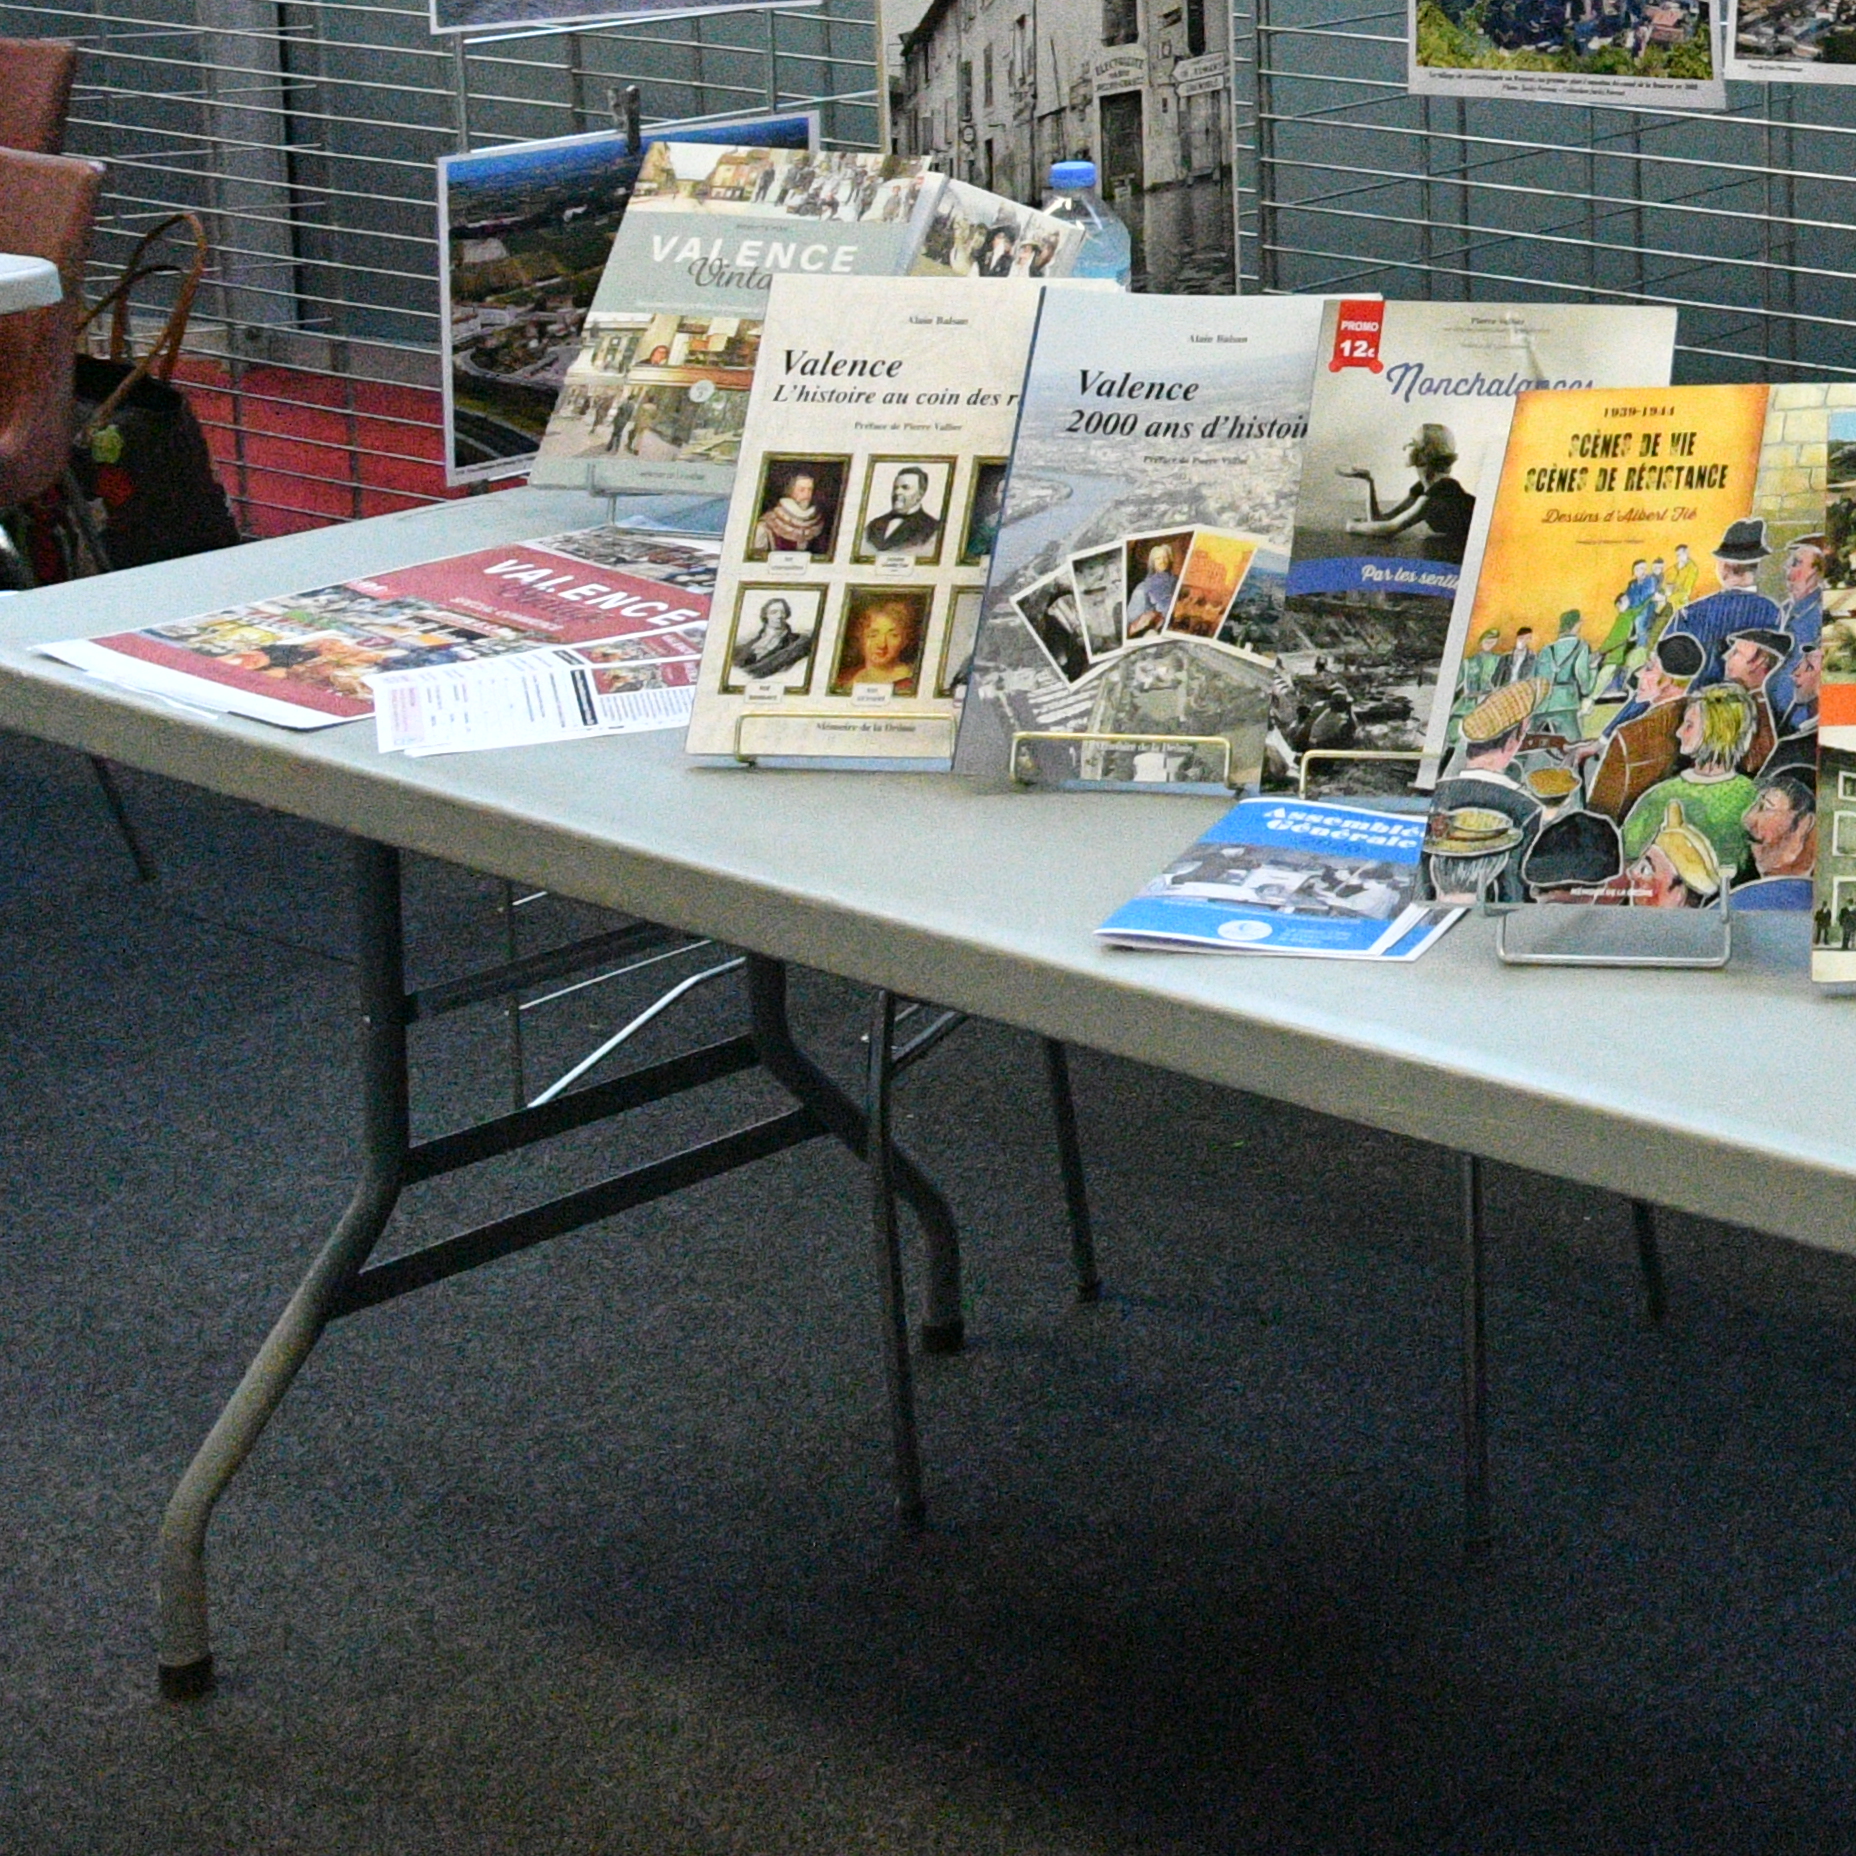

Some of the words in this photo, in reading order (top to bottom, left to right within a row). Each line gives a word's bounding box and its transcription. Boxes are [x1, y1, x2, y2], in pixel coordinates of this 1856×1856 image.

[651, 235, 858, 273] VALENCE
[687, 257, 773, 290] Vinta
[1341, 320, 1379, 332] PROMO
[783, 350, 903, 378] Valence
[773, 384, 876, 405] L'histoire
[882, 391, 909, 405] au
[916, 388, 960, 406] coin
[966, 388, 1000, 408] des
[1080, 368, 1199, 402] Valence
[1065, 409, 1138, 436] 2000
[1144, 417, 1194, 440] ans
[1201, 414, 1308, 440] d'histoi
[1603, 406, 1675, 418] 1939-1944
[1569, 429, 1632, 458] SCÈNES
[1639, 432, 1661, 457] DE
[1670, 431, 1697, 456] VIE
[1525, 463, 1588, 493] SCÈNES
[1595, 467, 1617, 492] DE
[1624, 463, 1729, 492] RÉSISTANCE
[1542, 508, 1599, 524] Dessins
[1362, 564, 1392, 584] Par
[1395, 566, 1417, 584] les
[484, 559, 698, 626] VALENCE
